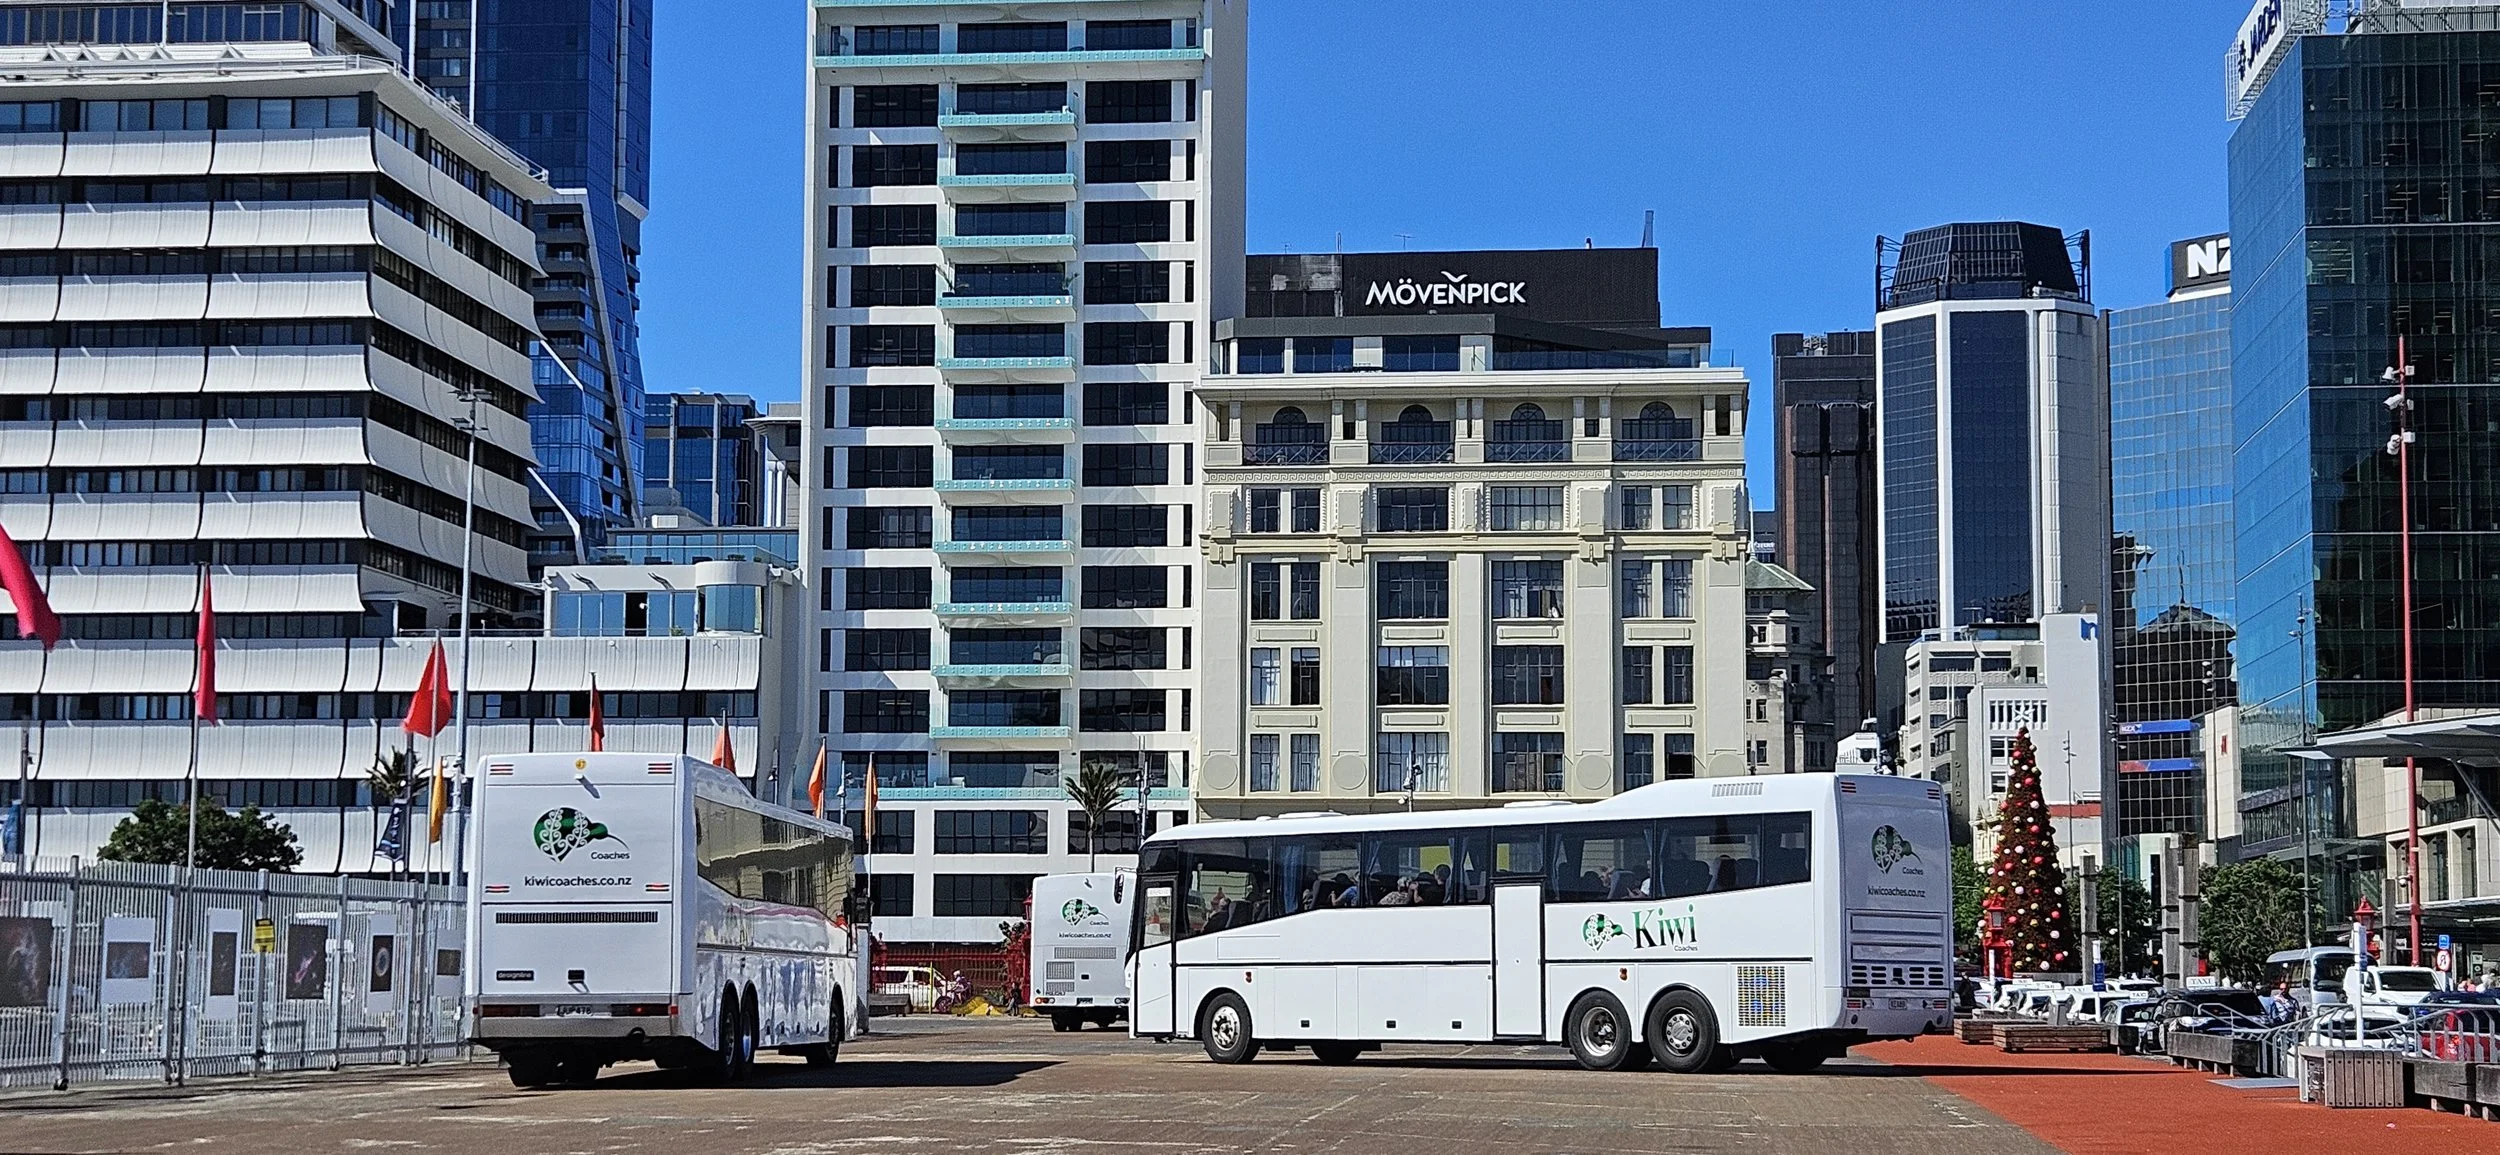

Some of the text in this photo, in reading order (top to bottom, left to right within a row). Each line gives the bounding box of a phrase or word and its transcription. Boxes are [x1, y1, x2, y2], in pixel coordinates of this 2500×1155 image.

[590, 851, 630, 860] Coaches
[1902, 866, 1924, 876] Coaches
[524, 875, 632, 886] kiwicoaches.co.nz
[1867, 885, 1926, 898] kiwicoaches.co.nz
[1632, 903, 1698, 950] Kiwi
